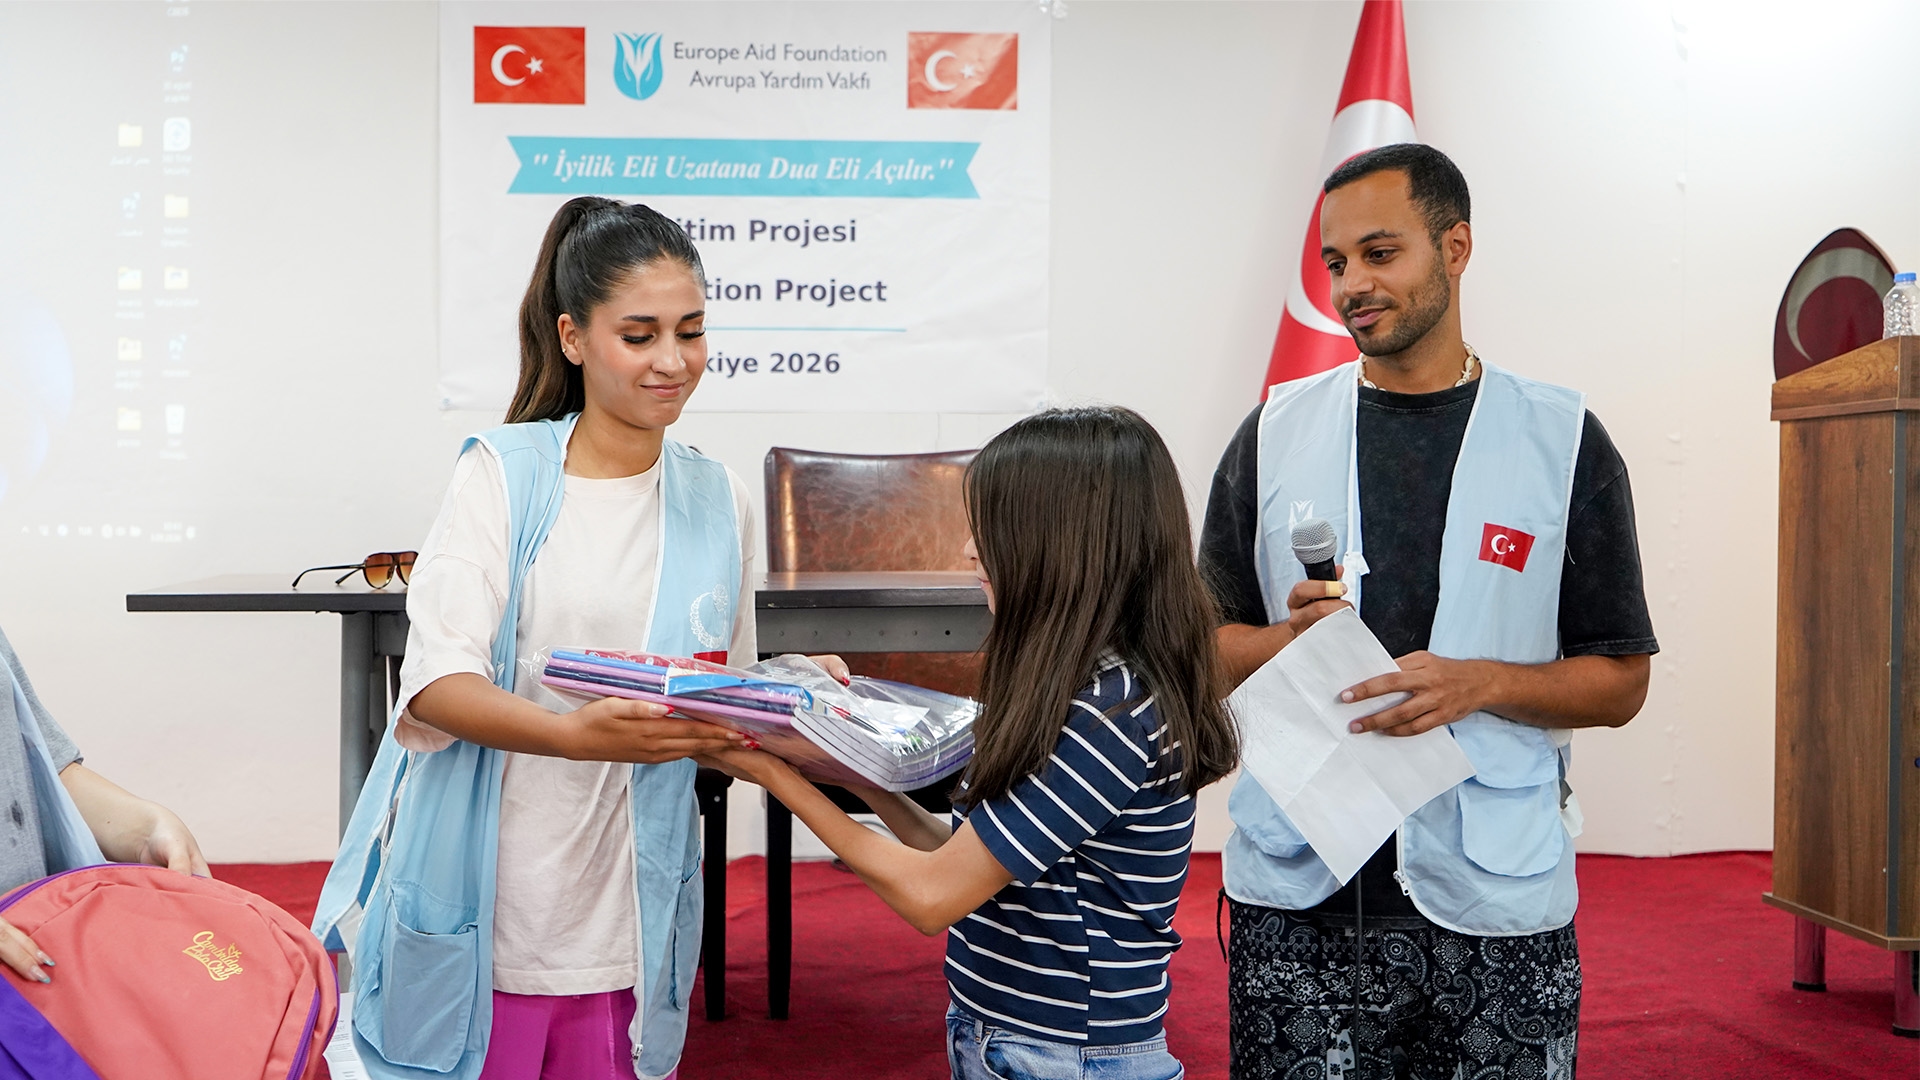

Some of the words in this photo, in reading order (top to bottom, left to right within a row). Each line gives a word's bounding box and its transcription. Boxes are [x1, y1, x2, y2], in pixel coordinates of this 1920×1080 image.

[674, 42, 740, 65] Europe
[744, 44, 776, 61] Aid
[783, 44, 888, 62] Foundation
[689, 70, 756, 93] Avrupa
[760, 71, 824, 89] Yardım
[554, 149, 614, 182] İyilik
[623, 156, 658, 177] Eli
[665, 156, 761, 180] Uzatana
[768, 157, 818, 179] Dua
[825, 158, 861, 180] Eli
[677, 219, 734, 241] tim
[750, 219, 856, 248] Projesi
[705, 279, 761, 300] tion
[777, 279, 887, 307] Project
[770, 353, 840, 373] 2026
[193, 931, 243, 974] Cambridge
